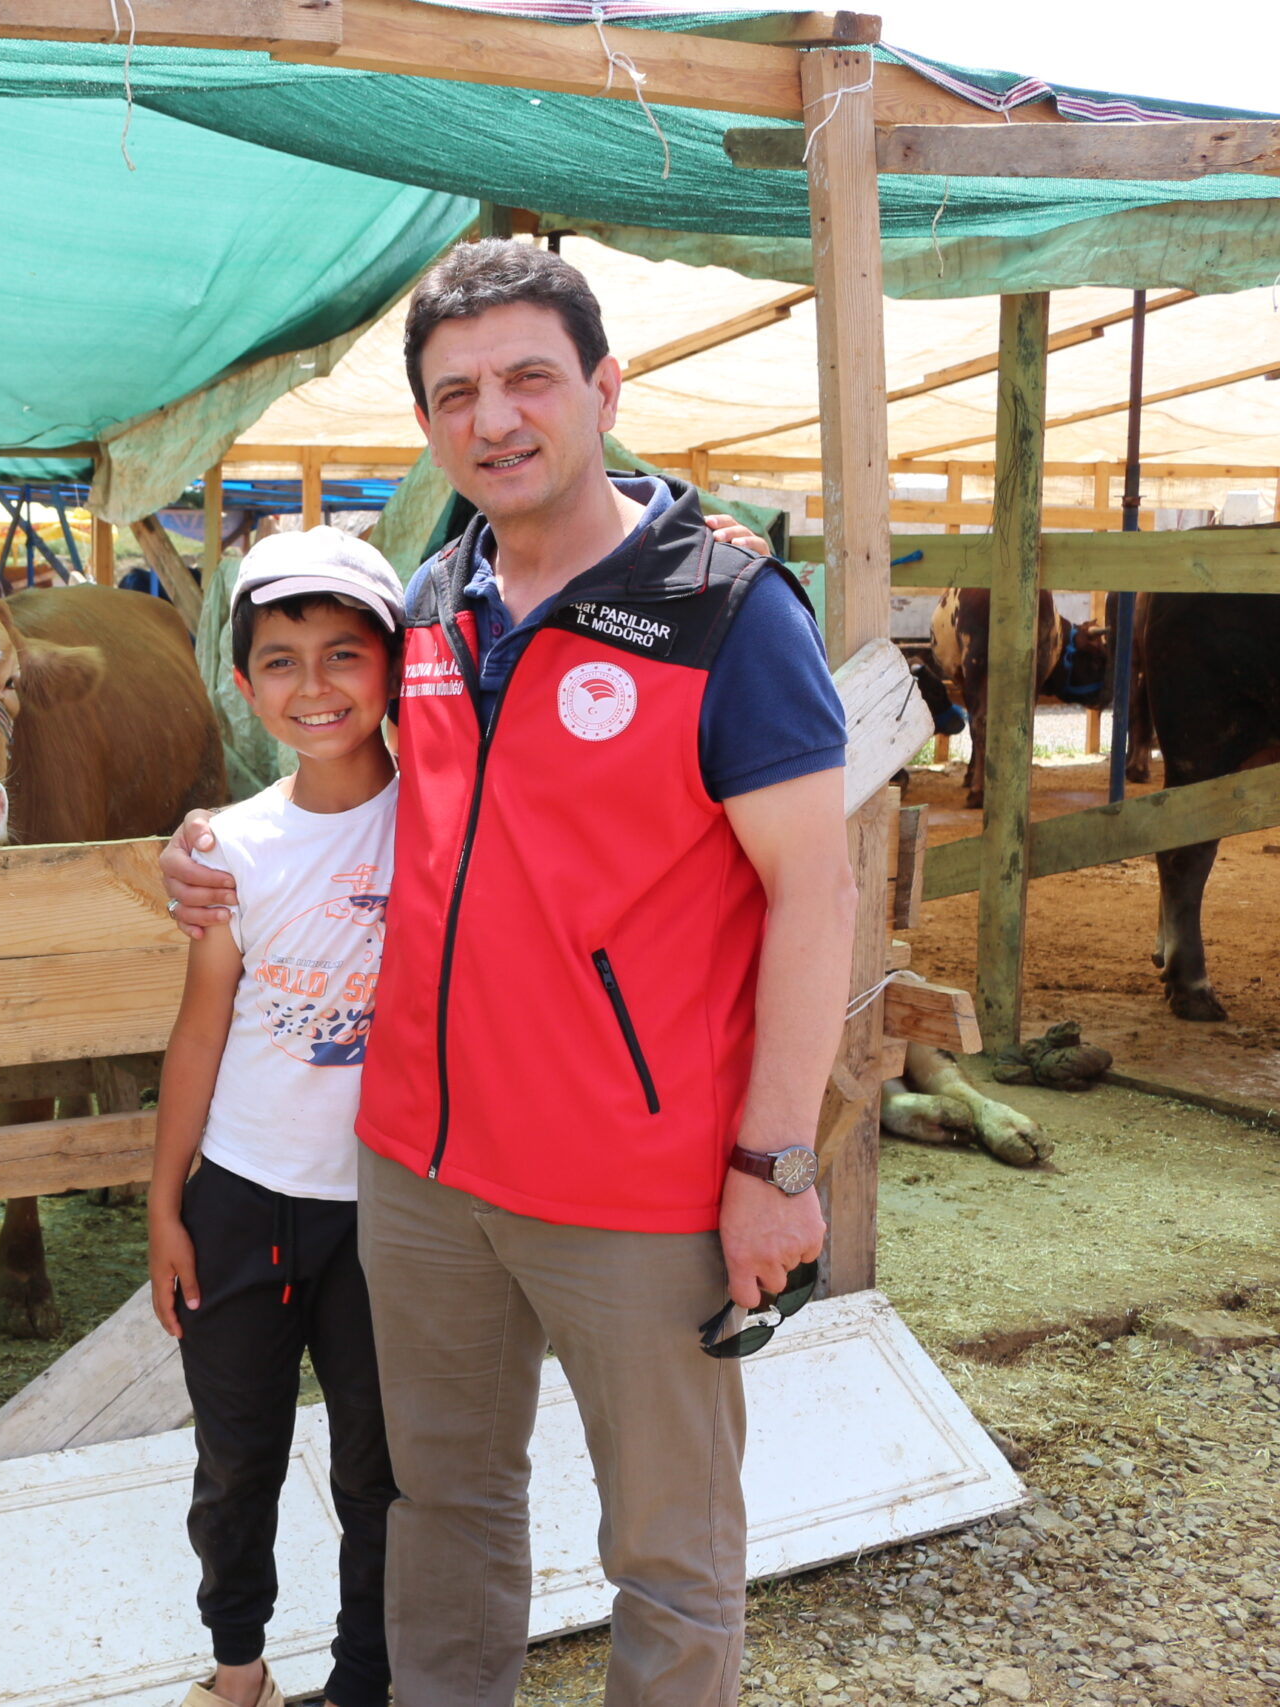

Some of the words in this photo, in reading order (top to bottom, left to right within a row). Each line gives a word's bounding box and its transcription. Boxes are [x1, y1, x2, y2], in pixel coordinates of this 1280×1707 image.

[569, 602, 596, 614] uat
[599, 605, 671, 640] PARILDAR
[576, 610, 589, 626] İL
[591, 617, 655, 648] MÜDÜRÜ
